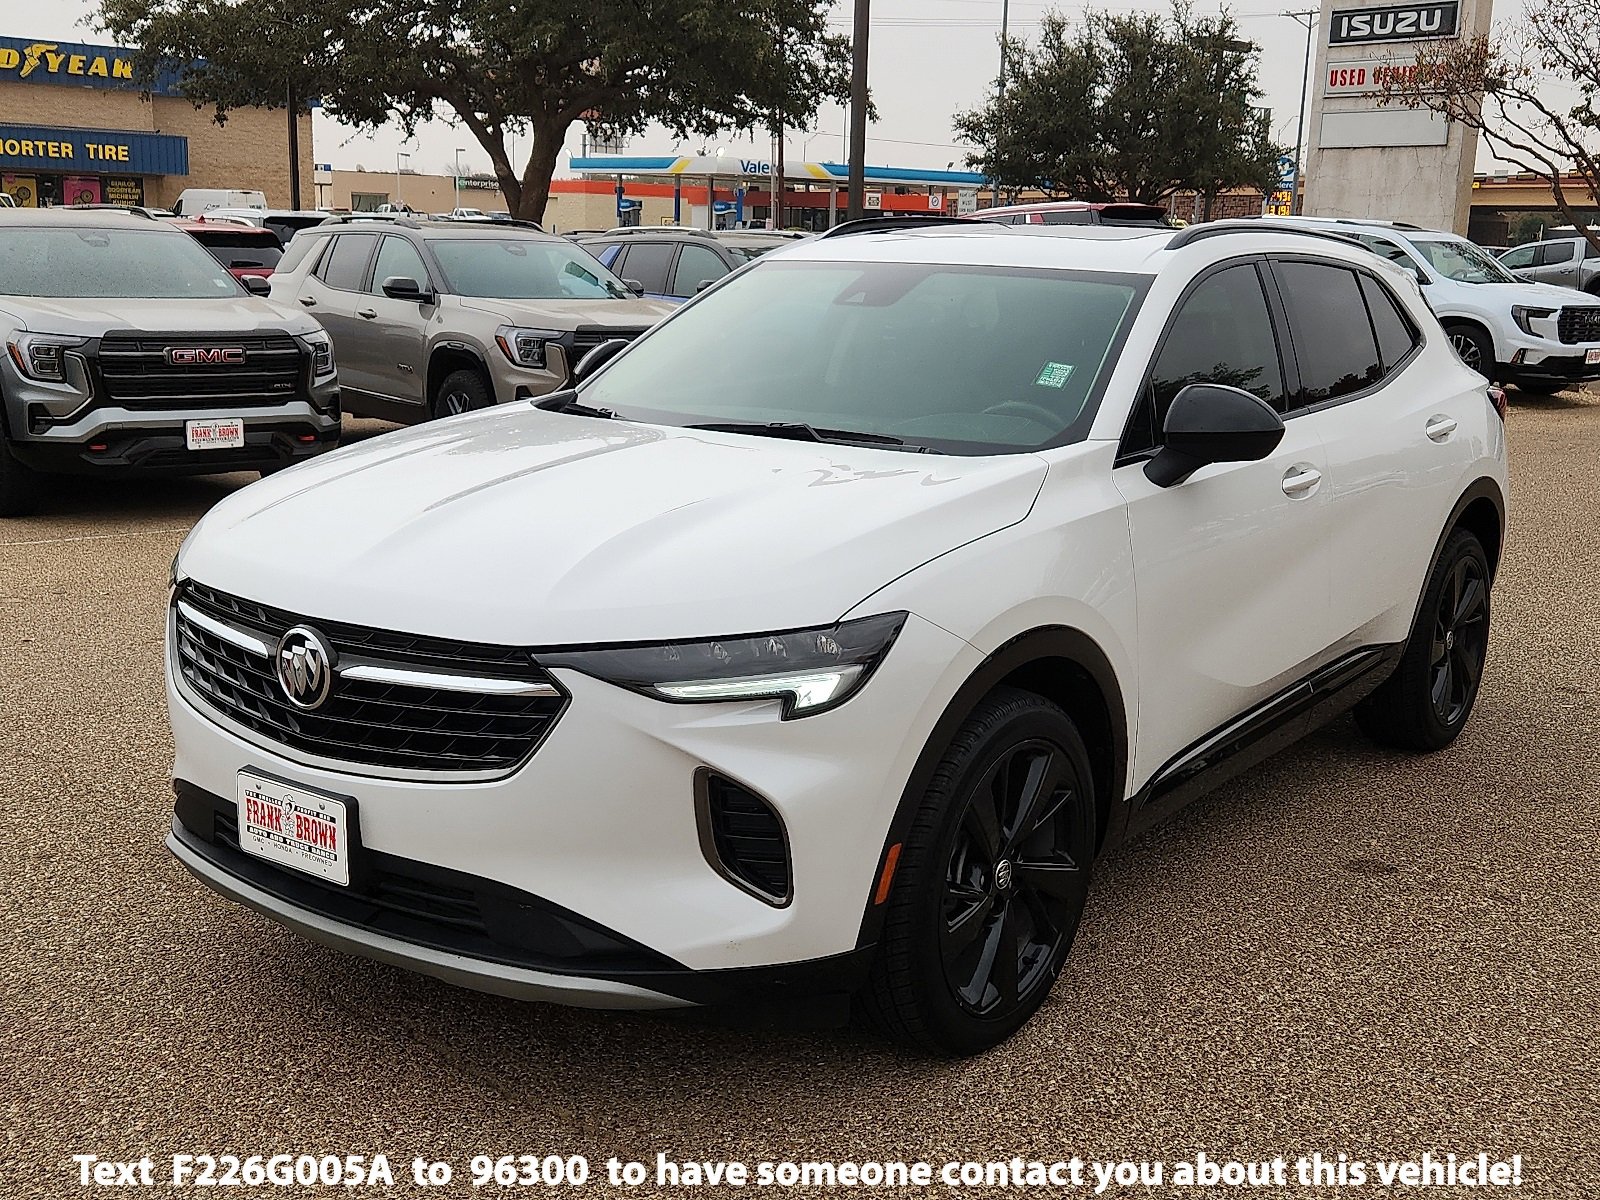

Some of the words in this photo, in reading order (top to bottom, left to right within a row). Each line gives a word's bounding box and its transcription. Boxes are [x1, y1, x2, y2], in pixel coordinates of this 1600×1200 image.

[1340, 9, 1441, 38] ISUZU
[1329, 68, 1366, 87] USED
[85, 143, 130, 161] TIRE
[458, 180, 500, 189] enterprise
[109, 193, 138, 201] MICHELIN
[172, 348, 244, 364] GMC
[191, 428, 212, 439] FRANK
[218, 427, 239, 438] BROWN
[245, 797, 283, 833] FRANK
[295, 813, 337, 852] BROWN
[249, 826, 268, 838] AUTO
[269, 832, 284, 843] AND
[286, 837, 310, 851] TRUCK
[253, 835, 265, 844] GMC
[273, 842, 293, 854] HONDA
[302, 851, 333, 867] PREOWNED
